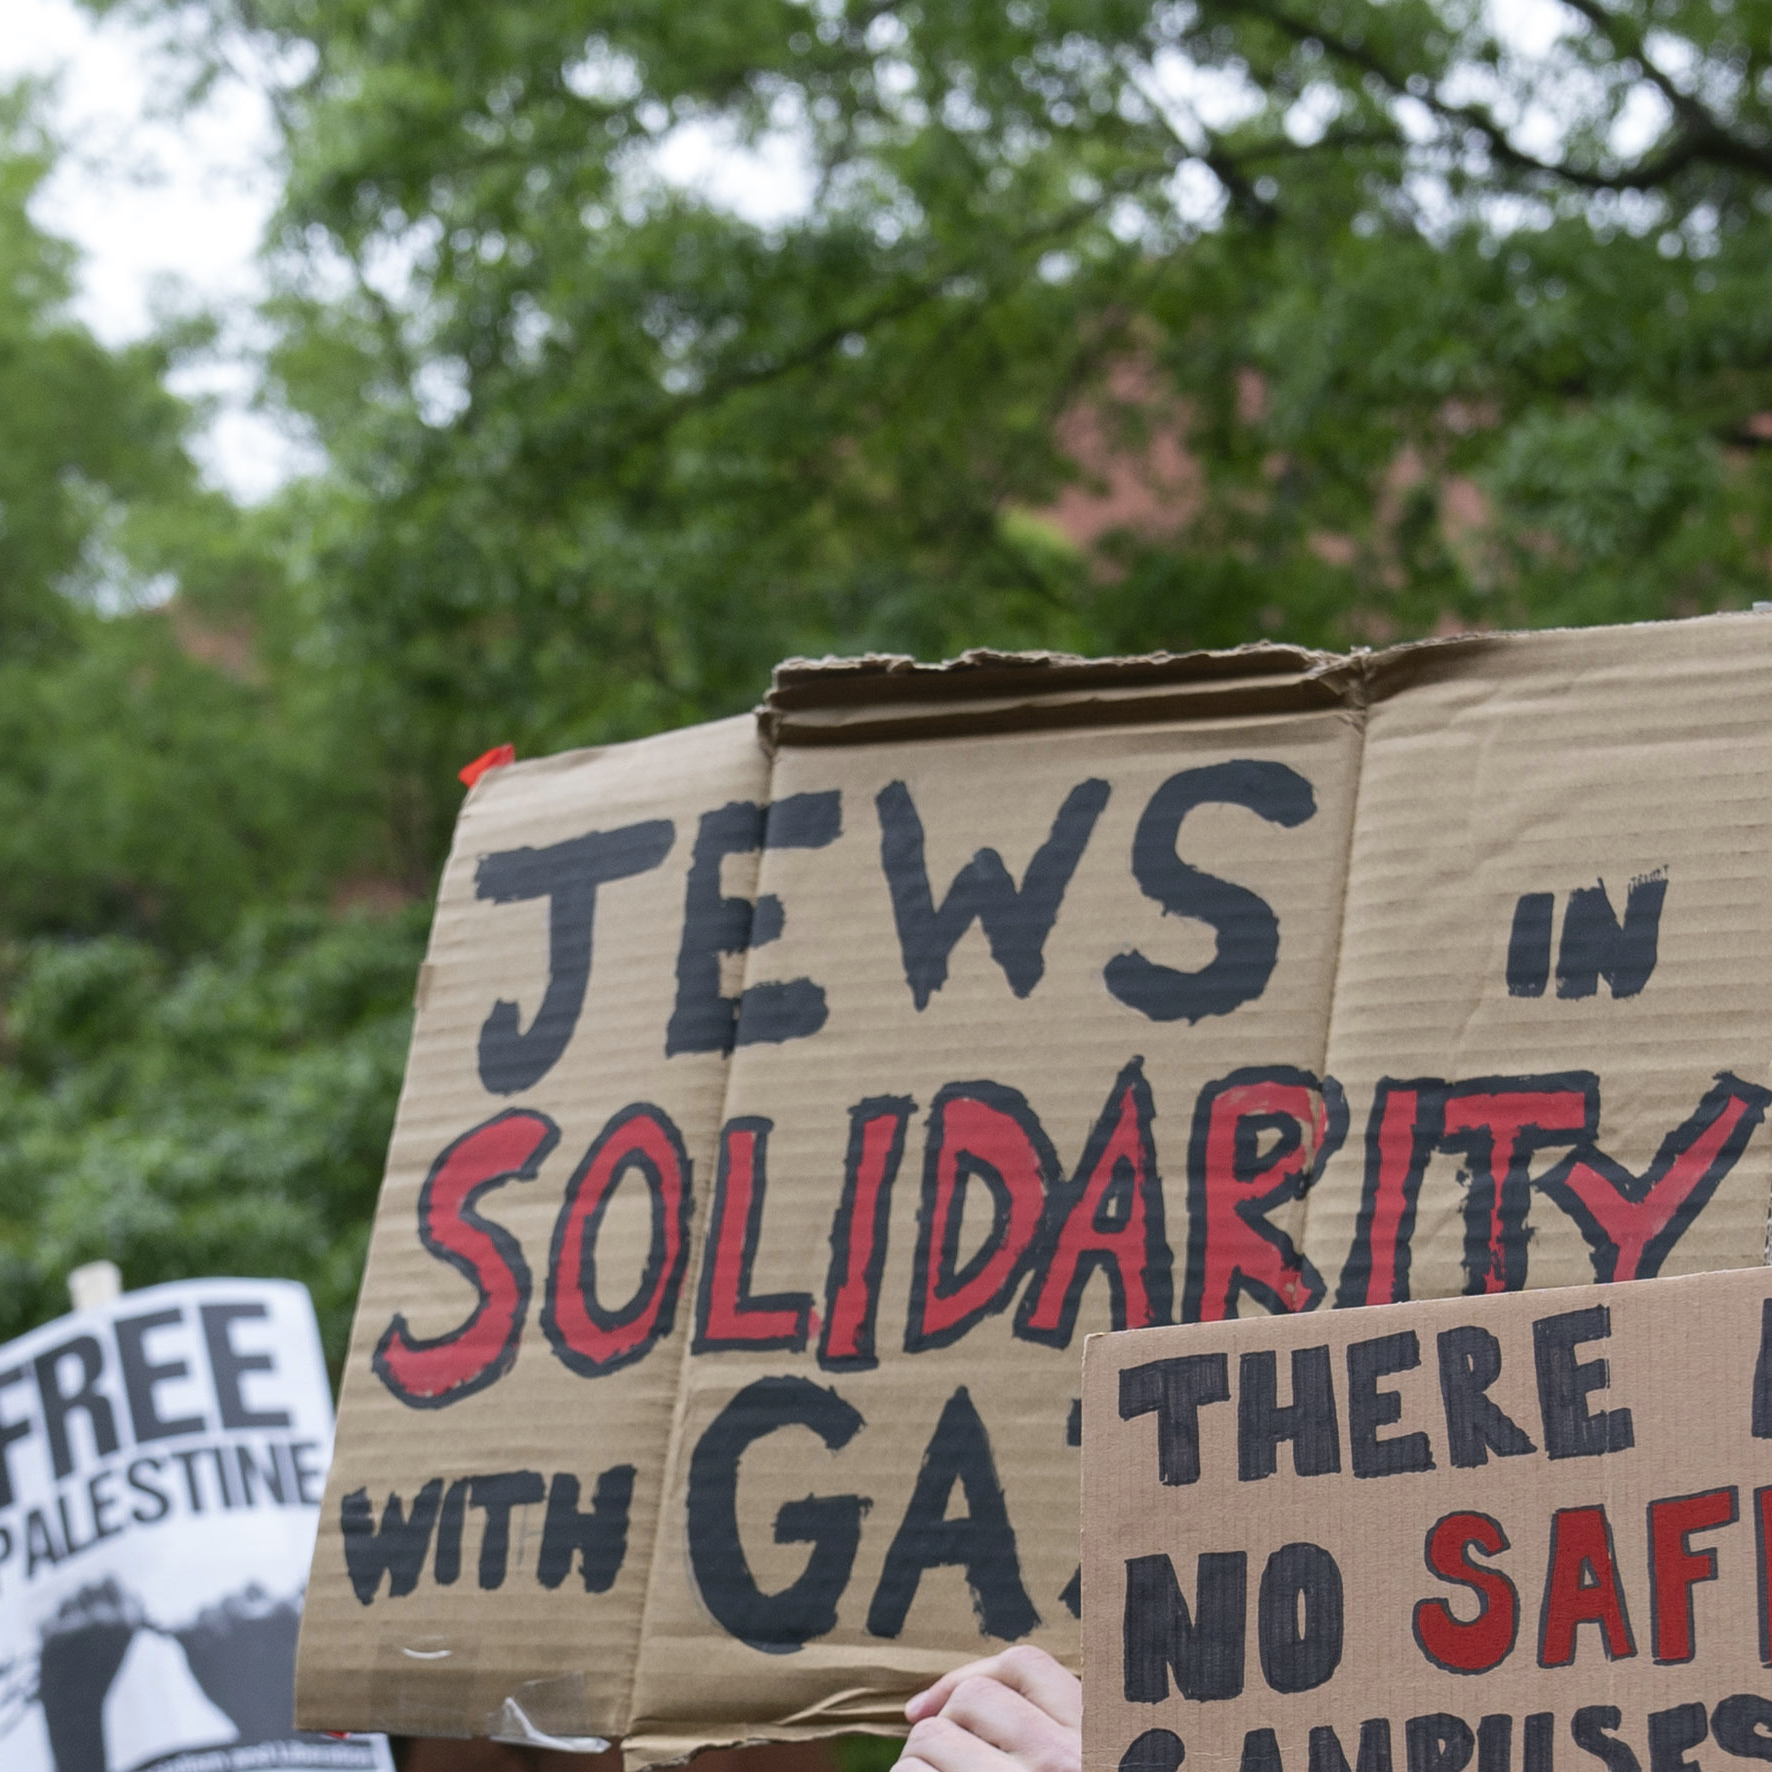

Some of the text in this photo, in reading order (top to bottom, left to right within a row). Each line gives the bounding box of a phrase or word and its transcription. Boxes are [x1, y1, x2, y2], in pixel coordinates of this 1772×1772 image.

[473, 759, 1668, 1096] JEWS IN
[373, 1055, 1772, 1409] SOLIDARITY
[339, 1375, 1082, 1655] WITH GA
[1117, 1303, 1634, 1487] THERE
[1122, 1541, 1345, 1704] NO
